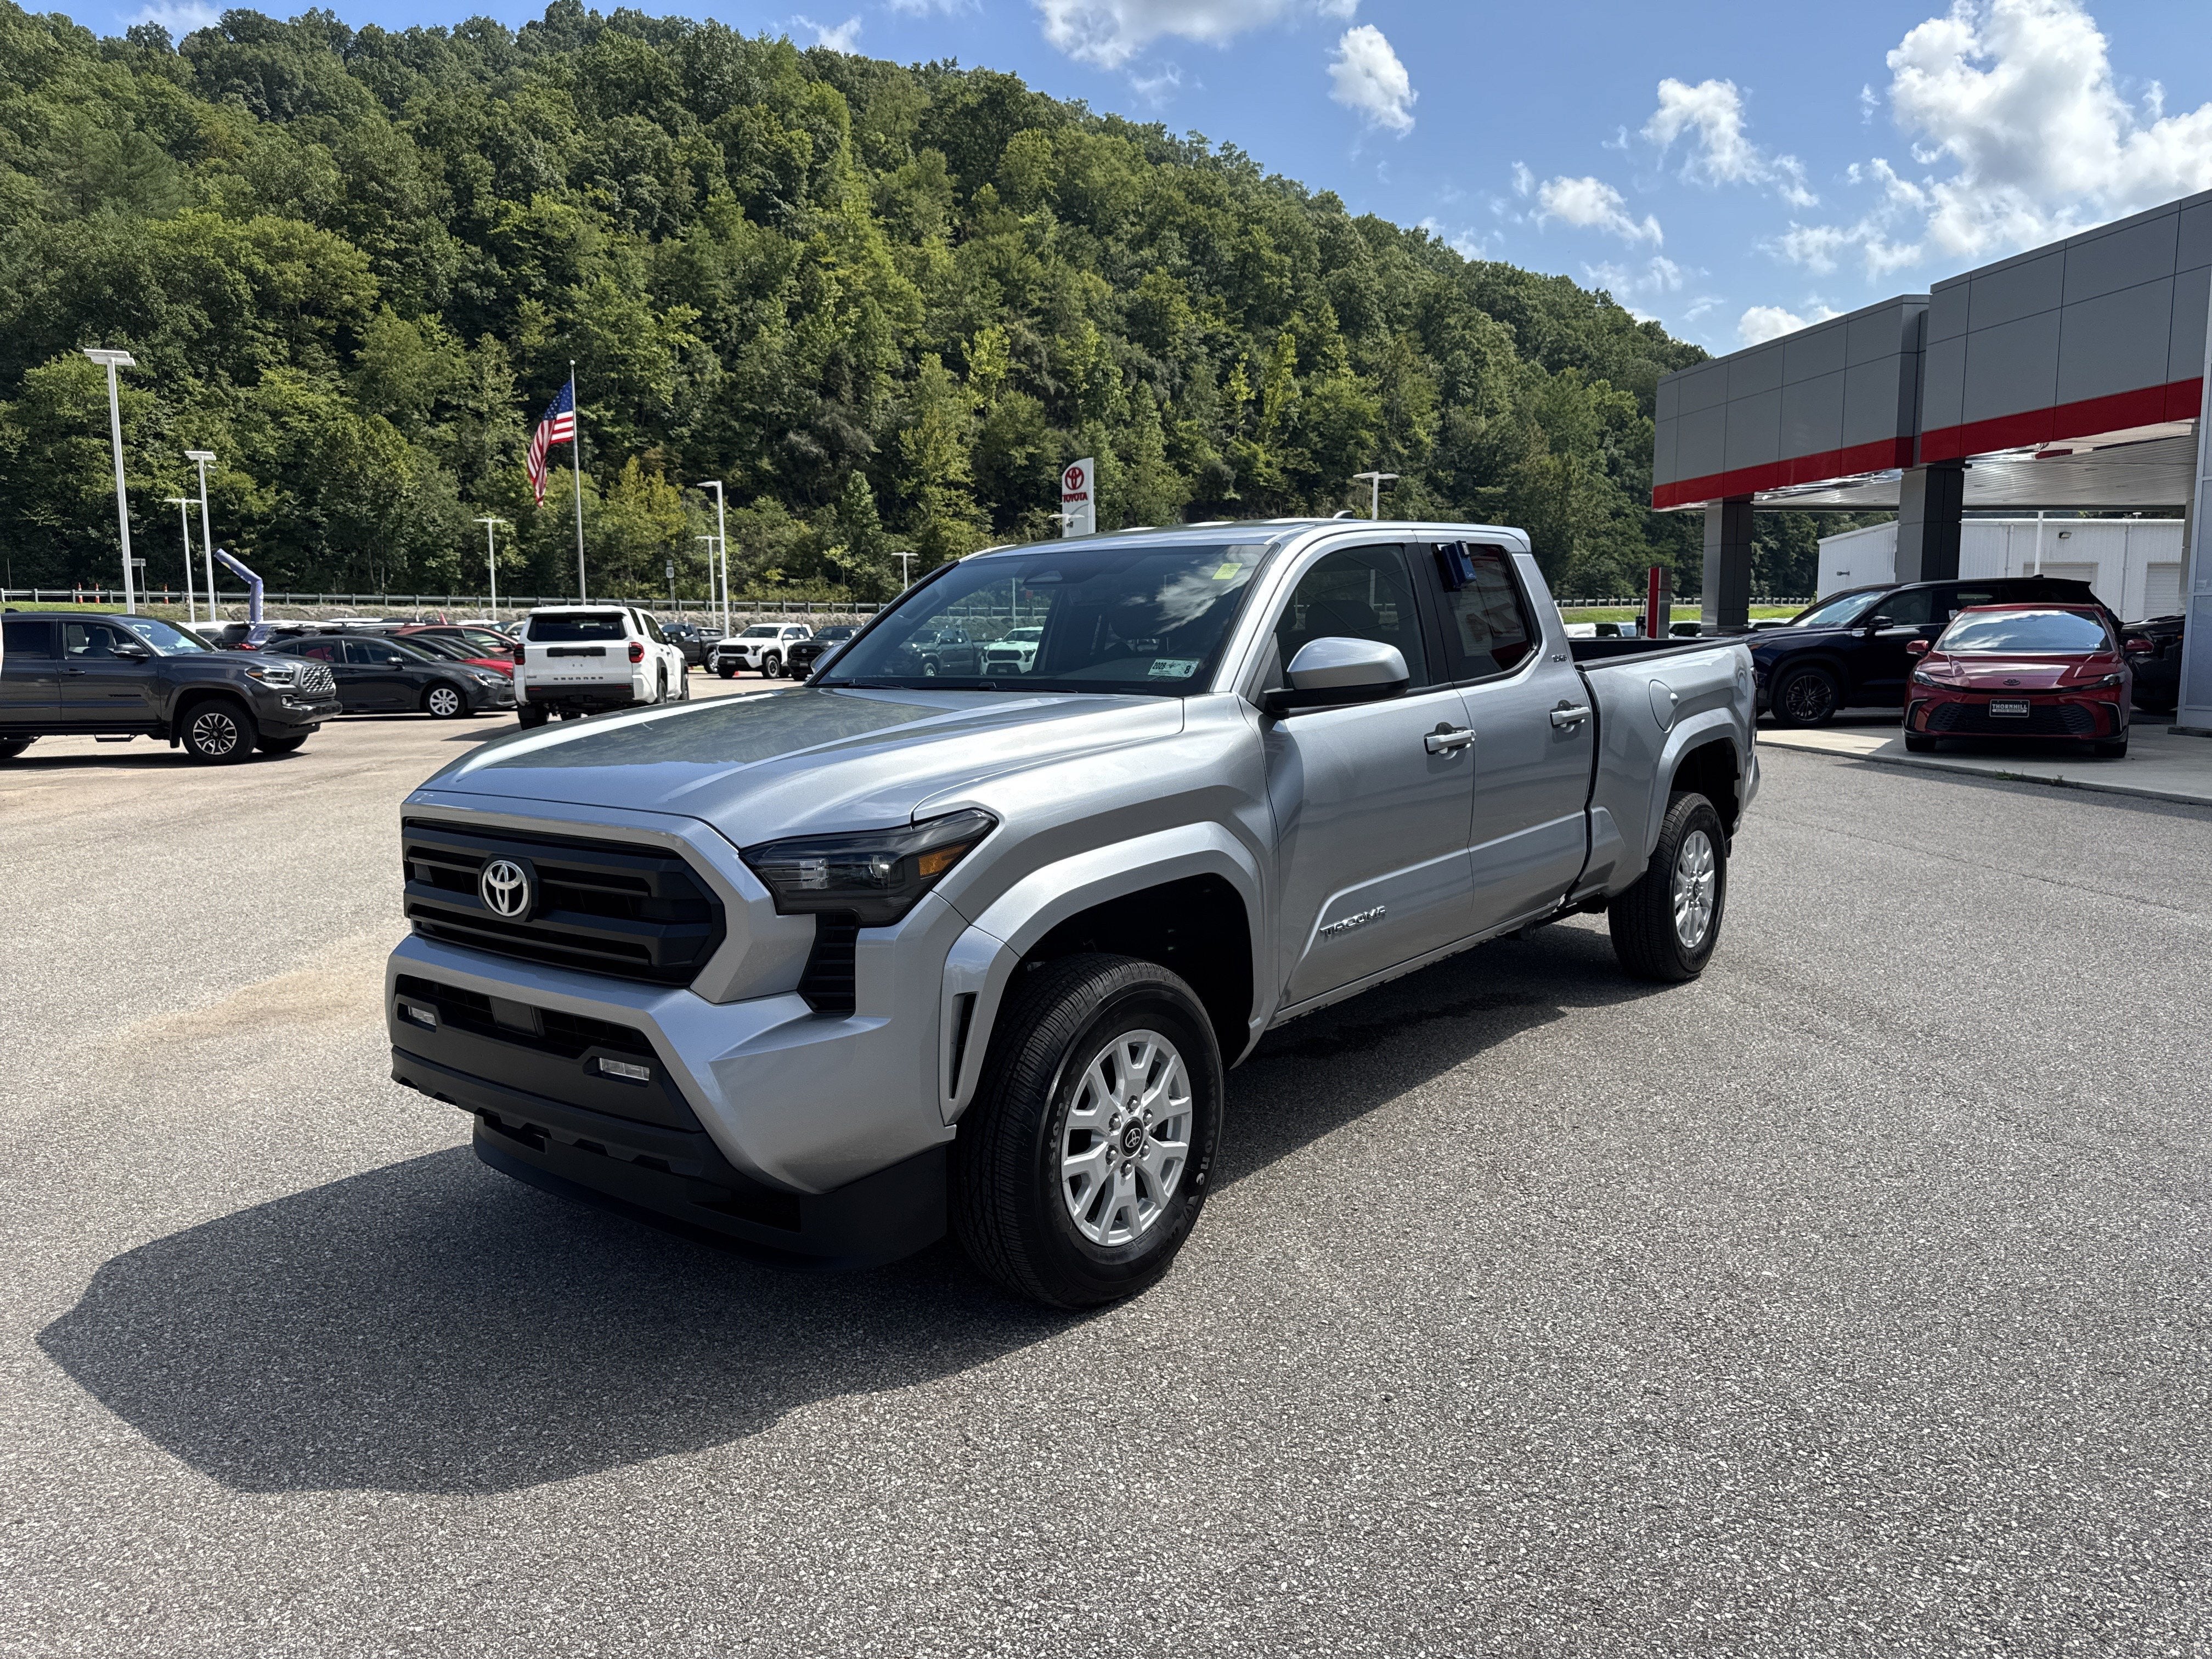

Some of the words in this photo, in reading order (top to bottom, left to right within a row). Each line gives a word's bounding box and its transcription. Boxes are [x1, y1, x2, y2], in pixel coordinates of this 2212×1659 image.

[1063, 492, 1088, 503] TOYOTA
[1152, 662, 1167, 670] 2028
[1184, 665, 1192, 674] 8
[1319, 905, 1387, 938] TACOMA
